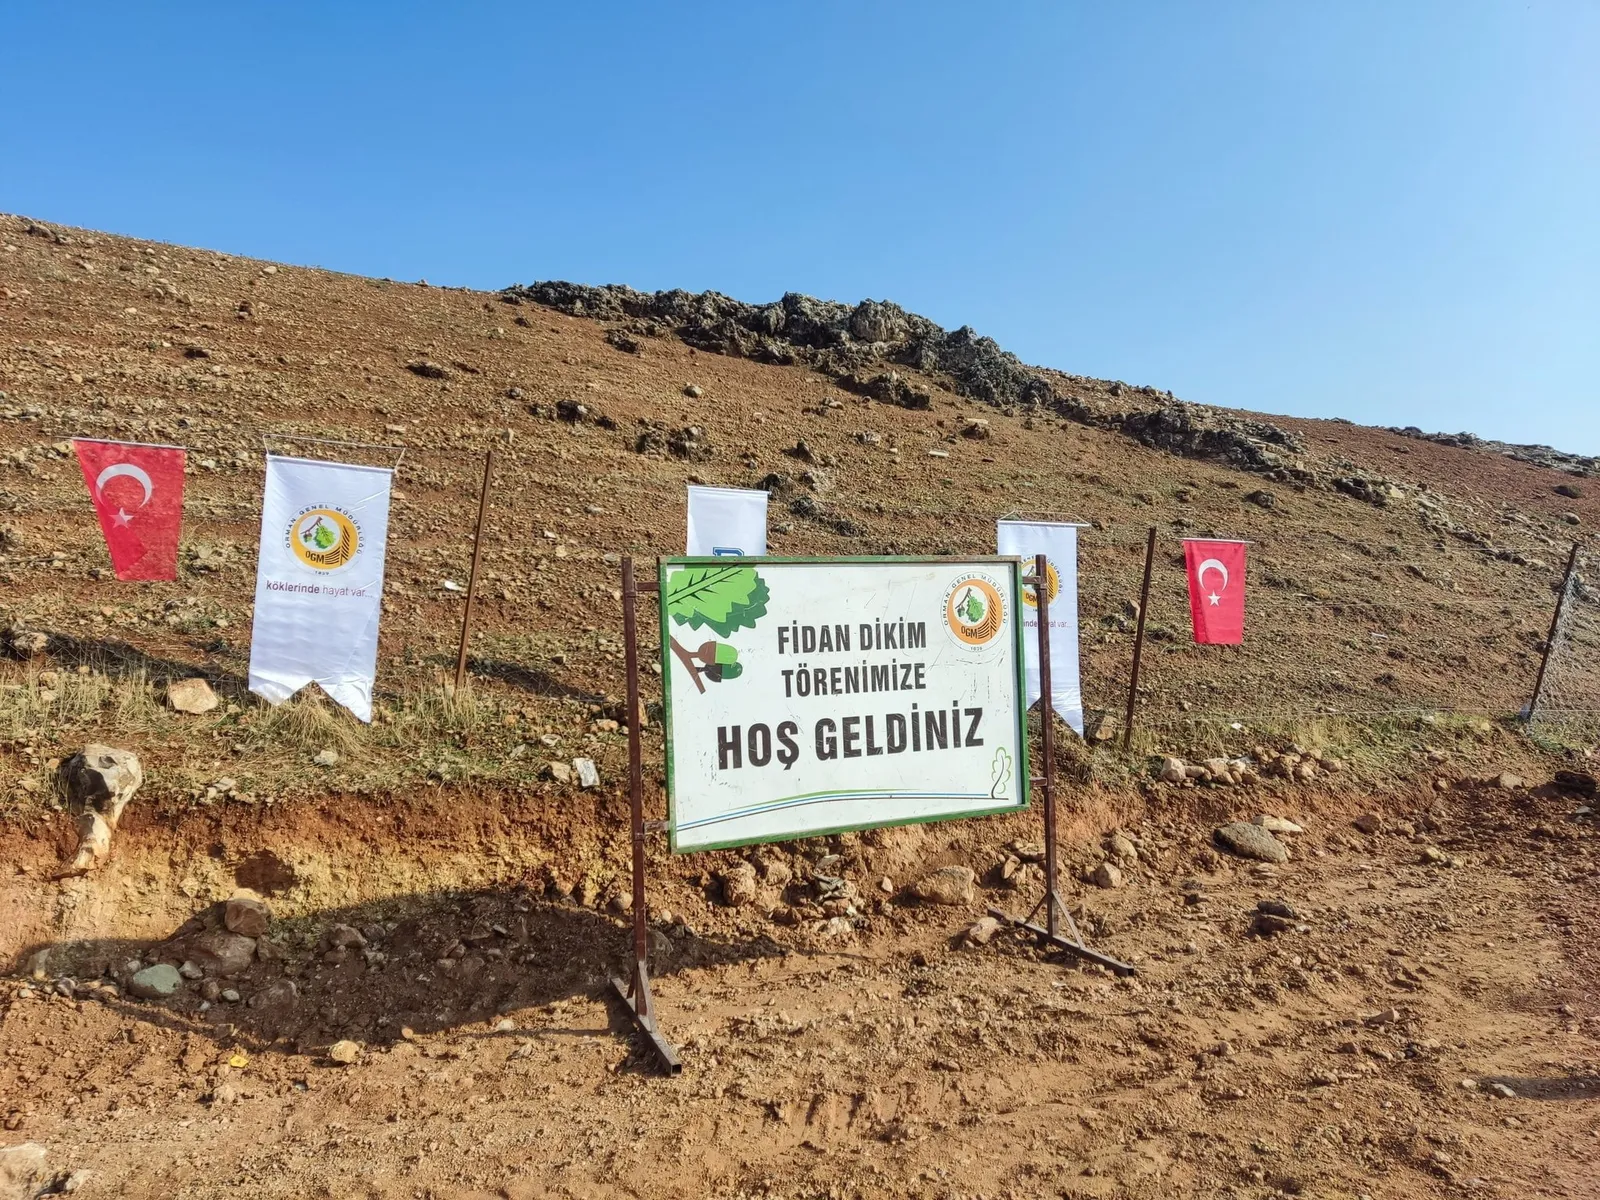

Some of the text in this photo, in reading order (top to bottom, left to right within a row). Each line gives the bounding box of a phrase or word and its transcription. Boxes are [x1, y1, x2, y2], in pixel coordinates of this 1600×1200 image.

[285, 517, 297, 549] ORMAN
[298, 504, 329, 516] GENEL
[305, 550, 326, 565] OGM
[265, 580, 320, 594] köklerinde
[322, 584, 349, 598] hayat
[942, 592, 951, 626] ORMAN
[951, 573, 976, 589] GENEL
[777, 616, 927, 655] FİDAN DİKİM
[960, 625, 978, 639] OGM
[781, 658, 927, 698] TÖRENİMİZE
[716, 700, 985, 771] HOŞ GELDİNİZ
